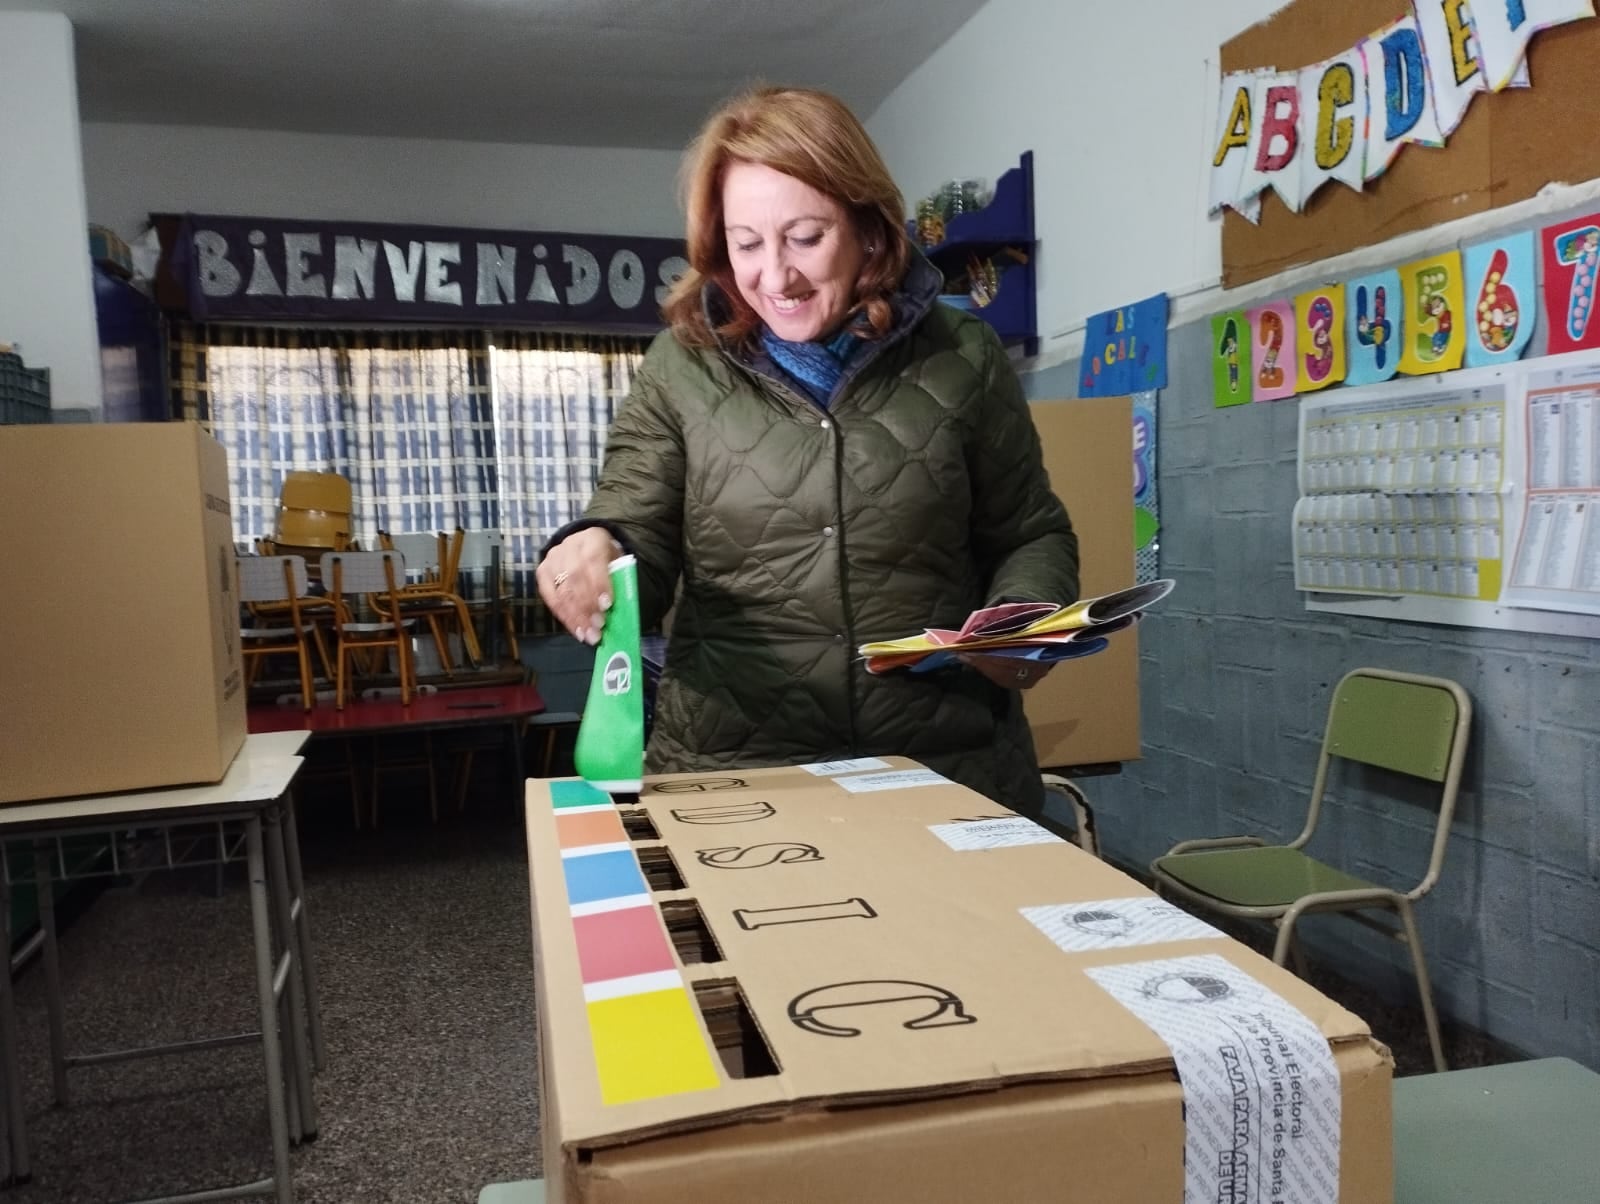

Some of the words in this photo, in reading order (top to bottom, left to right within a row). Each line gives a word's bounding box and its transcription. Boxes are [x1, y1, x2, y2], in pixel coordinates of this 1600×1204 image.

[1304, 296, 1336, 383] 3
[1356, 284, 1391, 370] 4
[1415, 263, 1454, 363] 5
[1475, 248, 1522, 353] 6
[1554, 225, 1600, 340] 7
[787, 980, 977, 1037] C
[1218, 1045, 1249, 1098] FAJA
[1255, 1037, 1287, 1119] Provincia
[1233, 1097, 1250, 1151] PARA
[1284, 1062, 1305, 1139] Electoral
[1273, 1122, 1287, 1143] de
[1271, 1147, 1286, 1197] Santa
